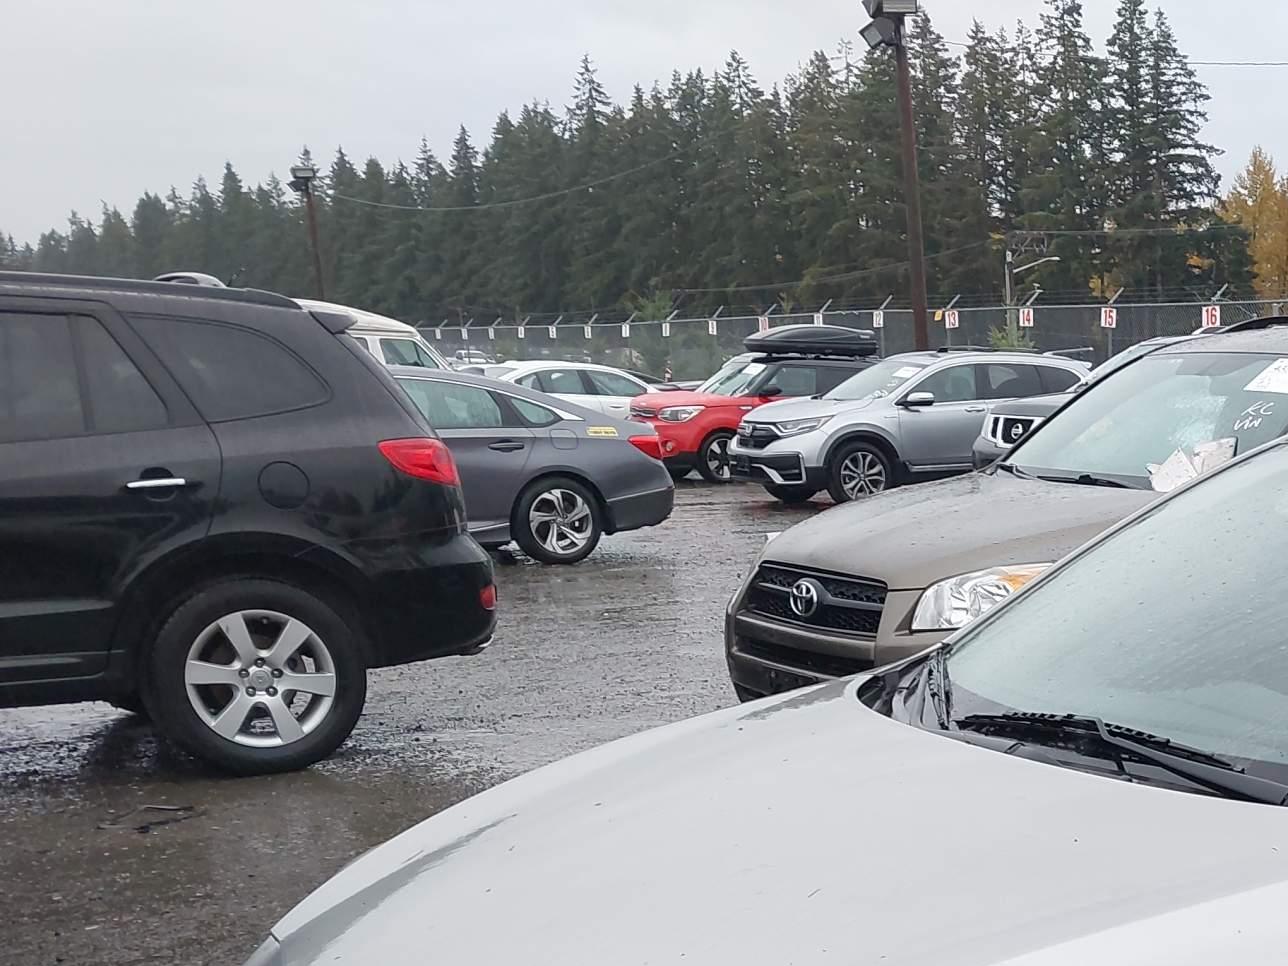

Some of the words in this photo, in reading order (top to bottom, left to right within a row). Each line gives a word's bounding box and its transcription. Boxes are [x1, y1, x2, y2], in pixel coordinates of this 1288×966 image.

[874, 311, 883, 326] 12
[947, 311, 957, 327] 13
[1021, 309, 1031, 325] 14
[1103, 309, 1114, 326] 15
[1204, 306, 1217, 326] 16
